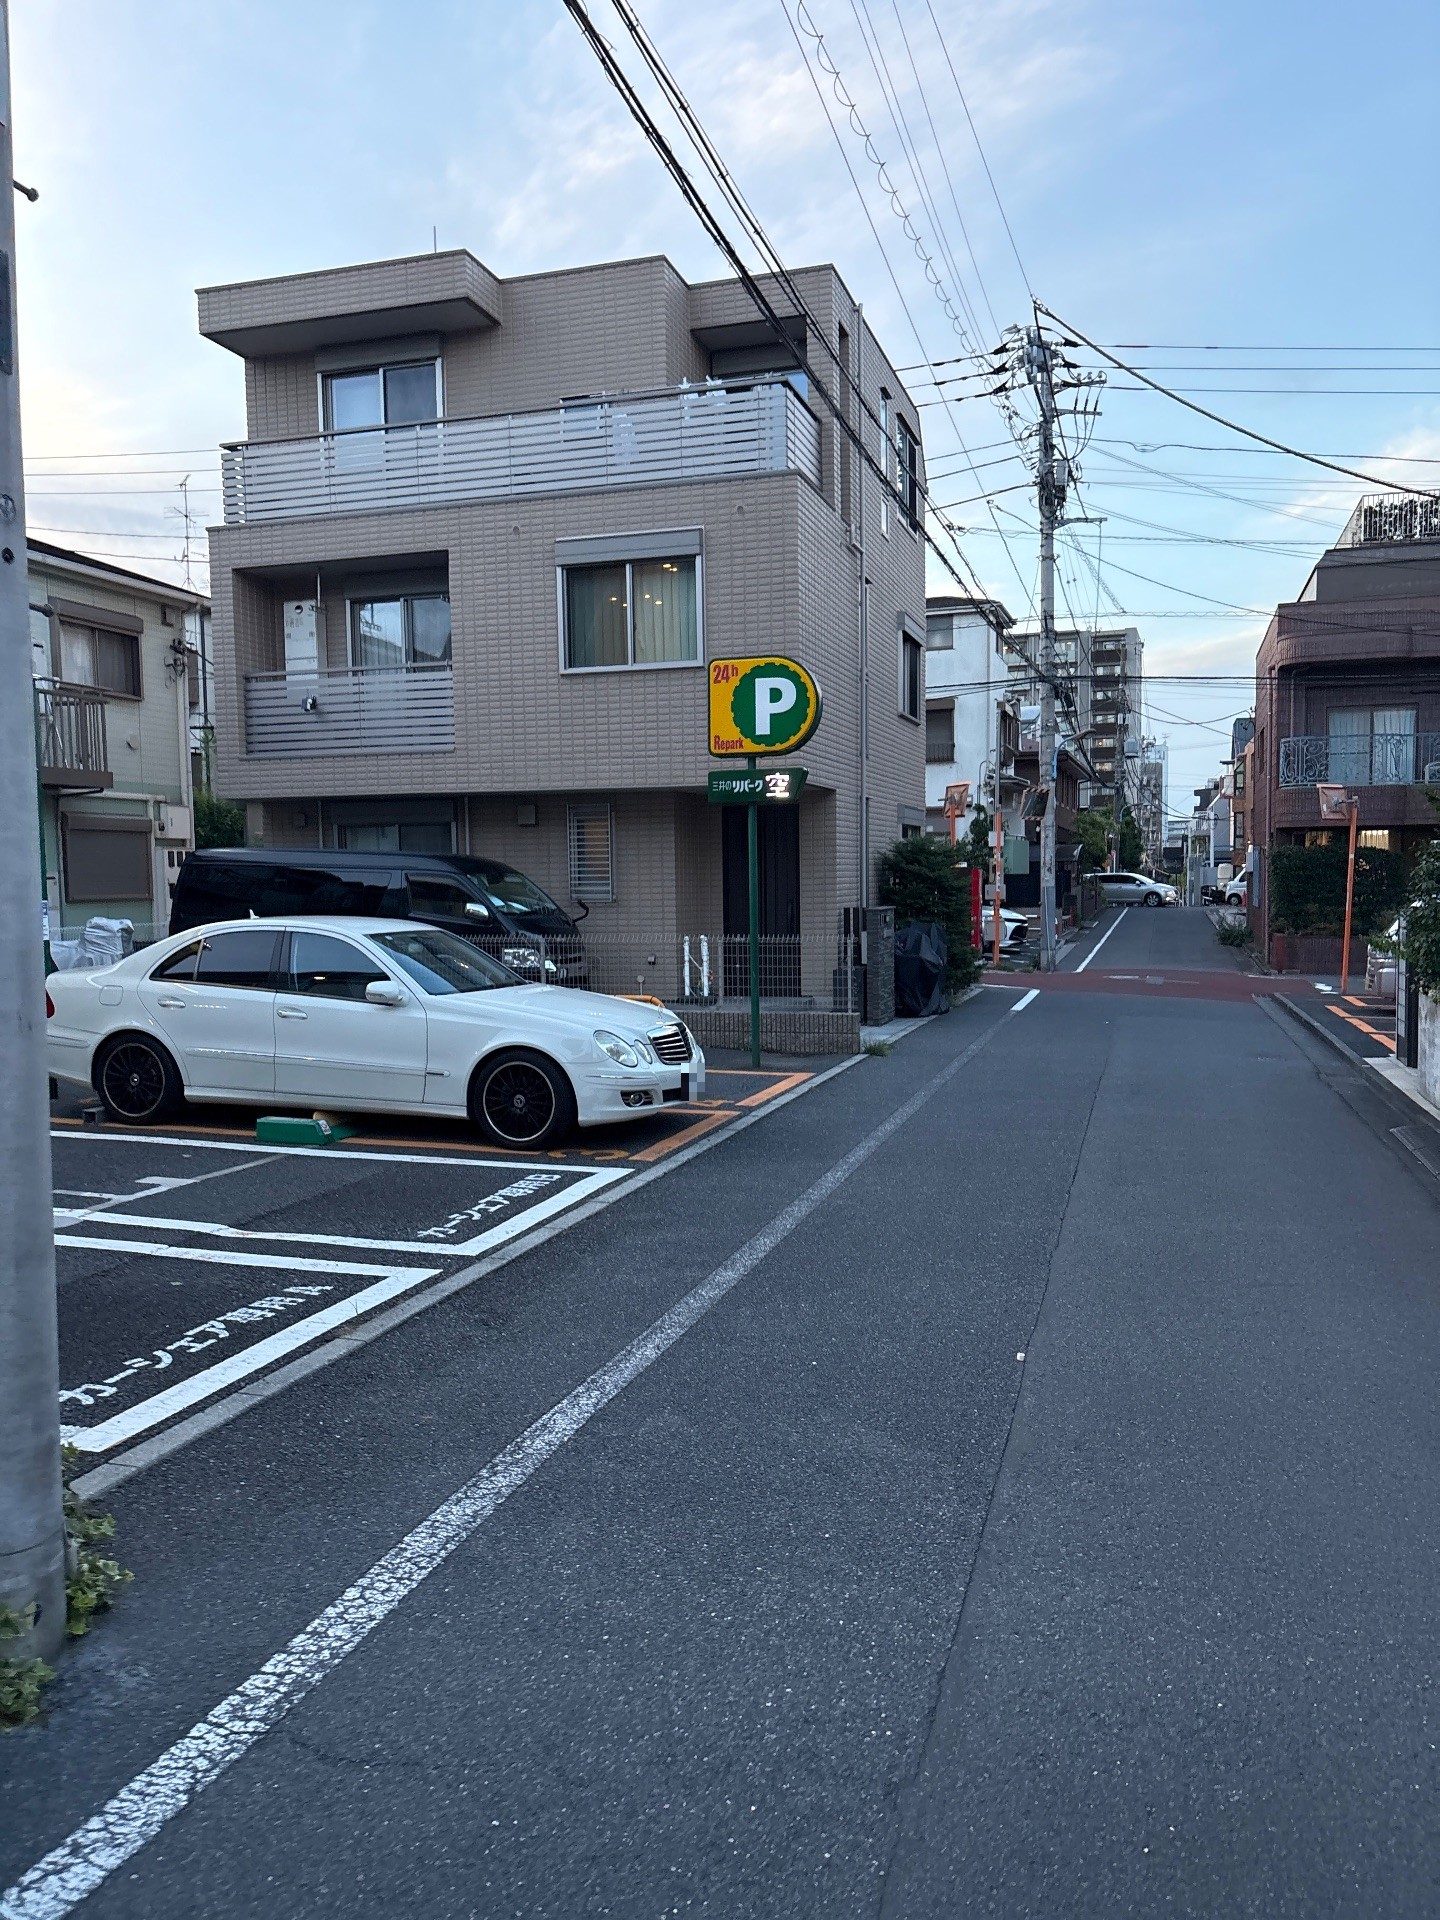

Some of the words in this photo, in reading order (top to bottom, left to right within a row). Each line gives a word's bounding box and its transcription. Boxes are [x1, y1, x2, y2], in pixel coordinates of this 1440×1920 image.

[713, 664, 739, 684] 24h
[755, 677, 797, 735] P
[713, 735, 744, 752] Repark
[712, 779, 763, 793] 三井のリパーク
[765, 772, 790, 798] 空
